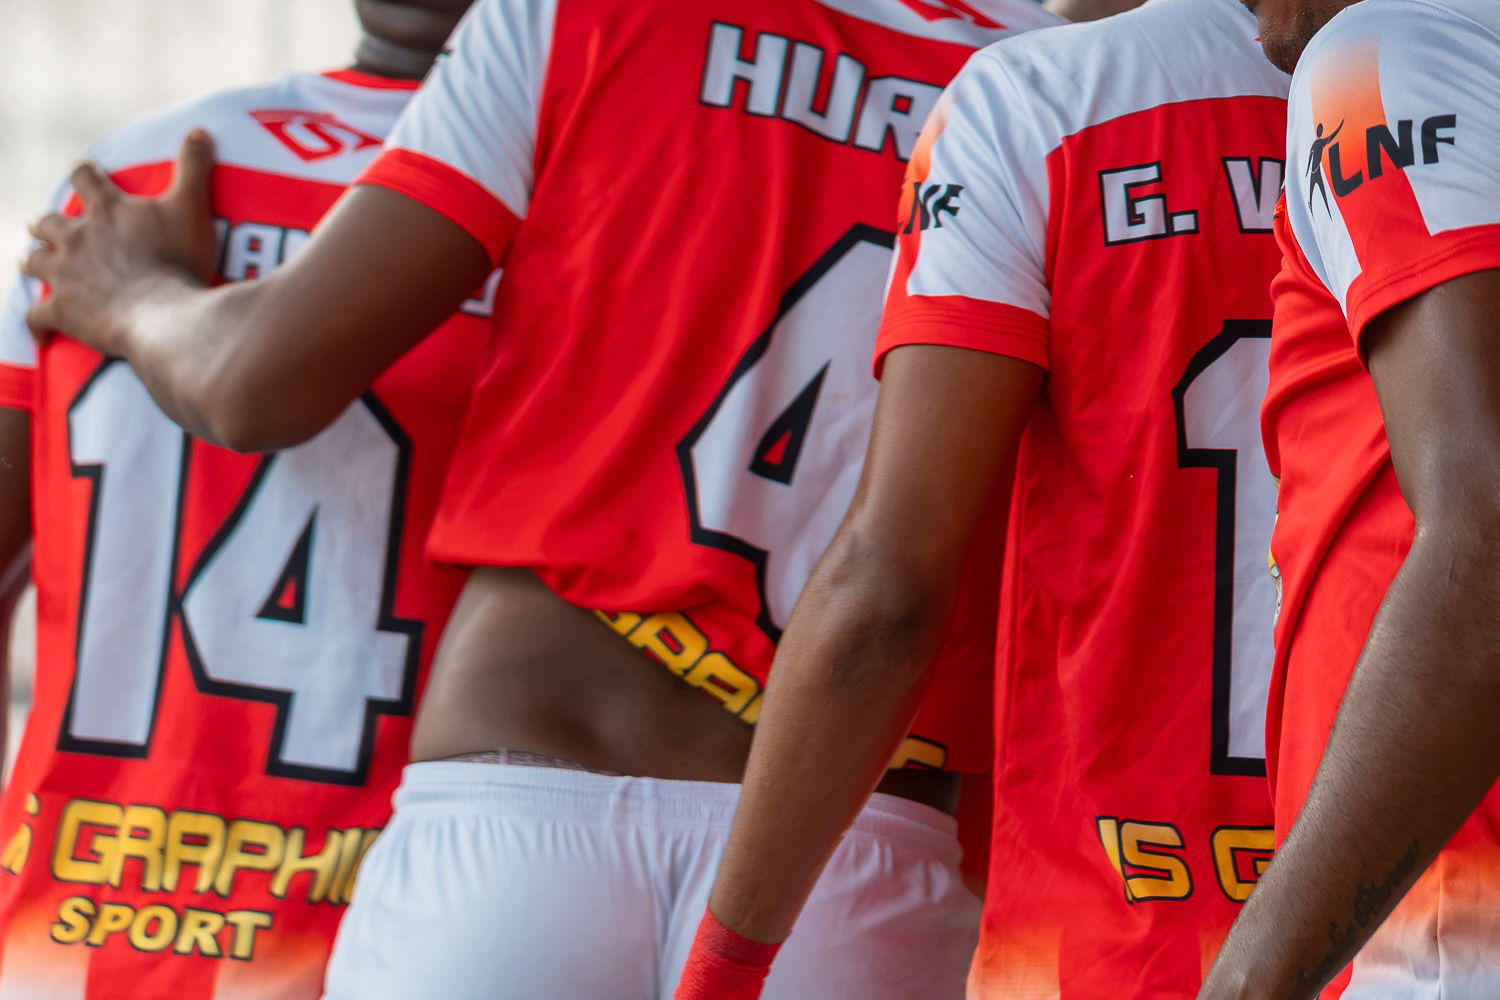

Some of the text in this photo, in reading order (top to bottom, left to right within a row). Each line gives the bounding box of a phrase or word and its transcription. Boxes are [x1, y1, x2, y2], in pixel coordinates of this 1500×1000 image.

[1326, 113, 1457, 198] LNF
[1098, 161, 1200, 247] G.
[57, 355, 425, 787] 14
[50, 895, 274, 961] SPORT
